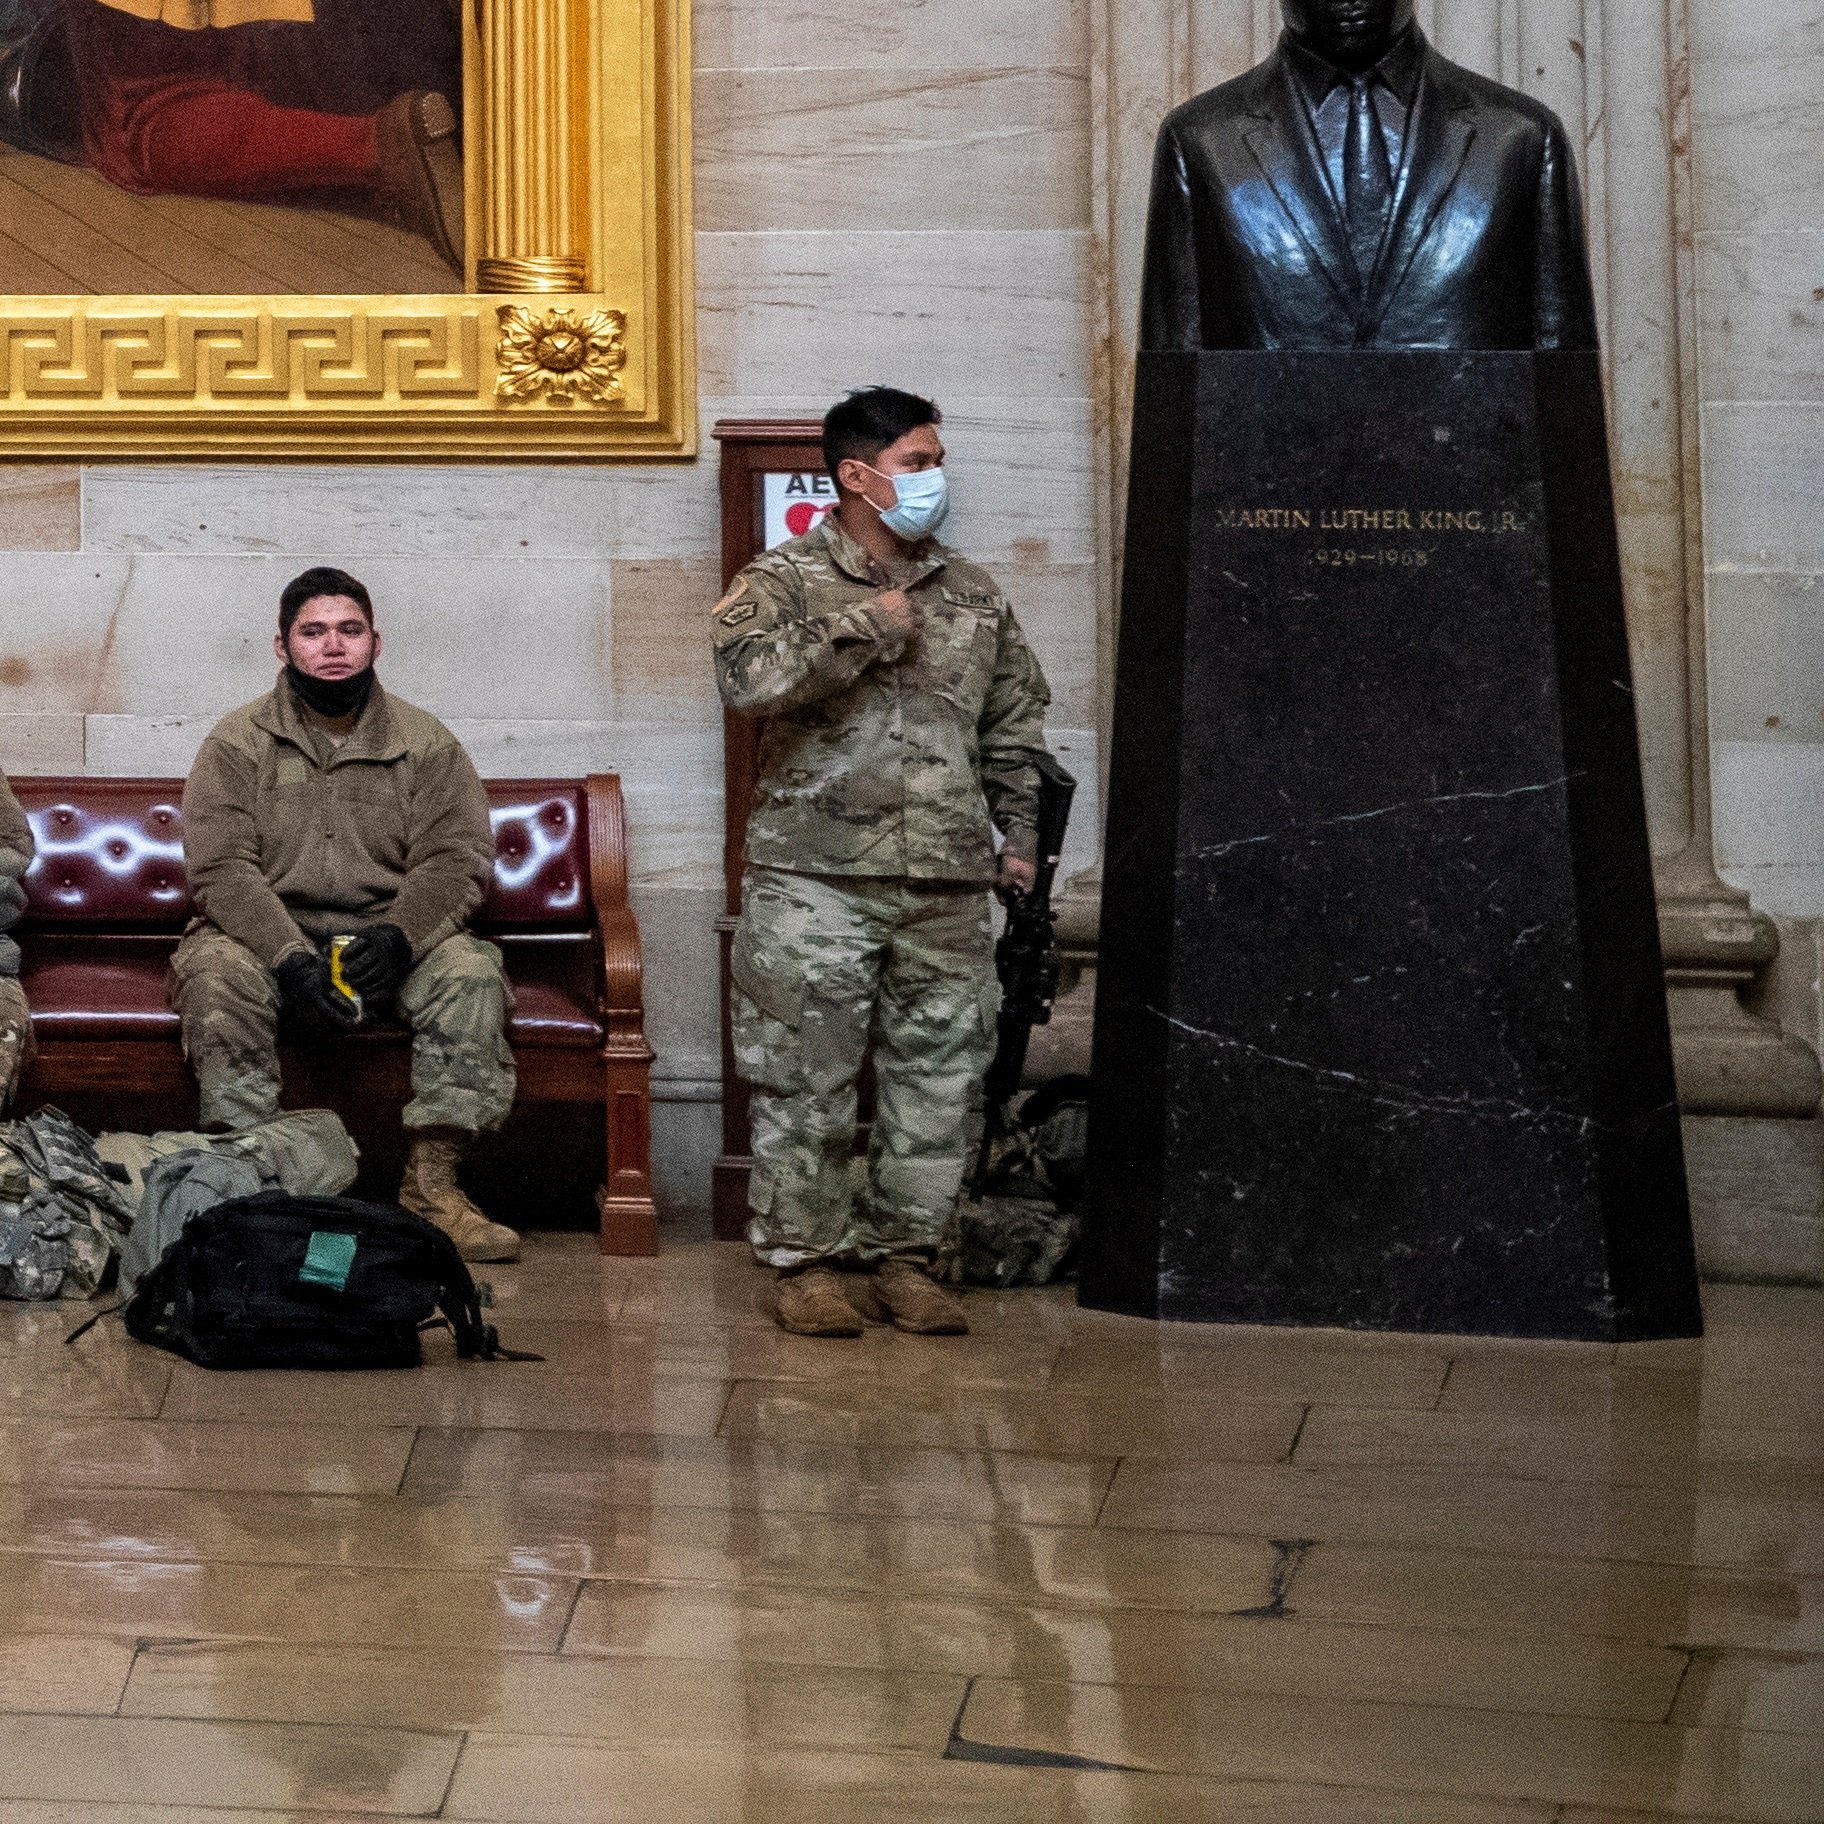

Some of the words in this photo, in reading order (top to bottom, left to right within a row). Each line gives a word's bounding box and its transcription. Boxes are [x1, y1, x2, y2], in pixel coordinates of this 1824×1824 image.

[785, 474, 831, 494] AE
[1214, 509, 1311, 530] MARTIN
[1320, 509, 1413, 530] LUTHER
[1419, 510, 1487, 534] KING,
